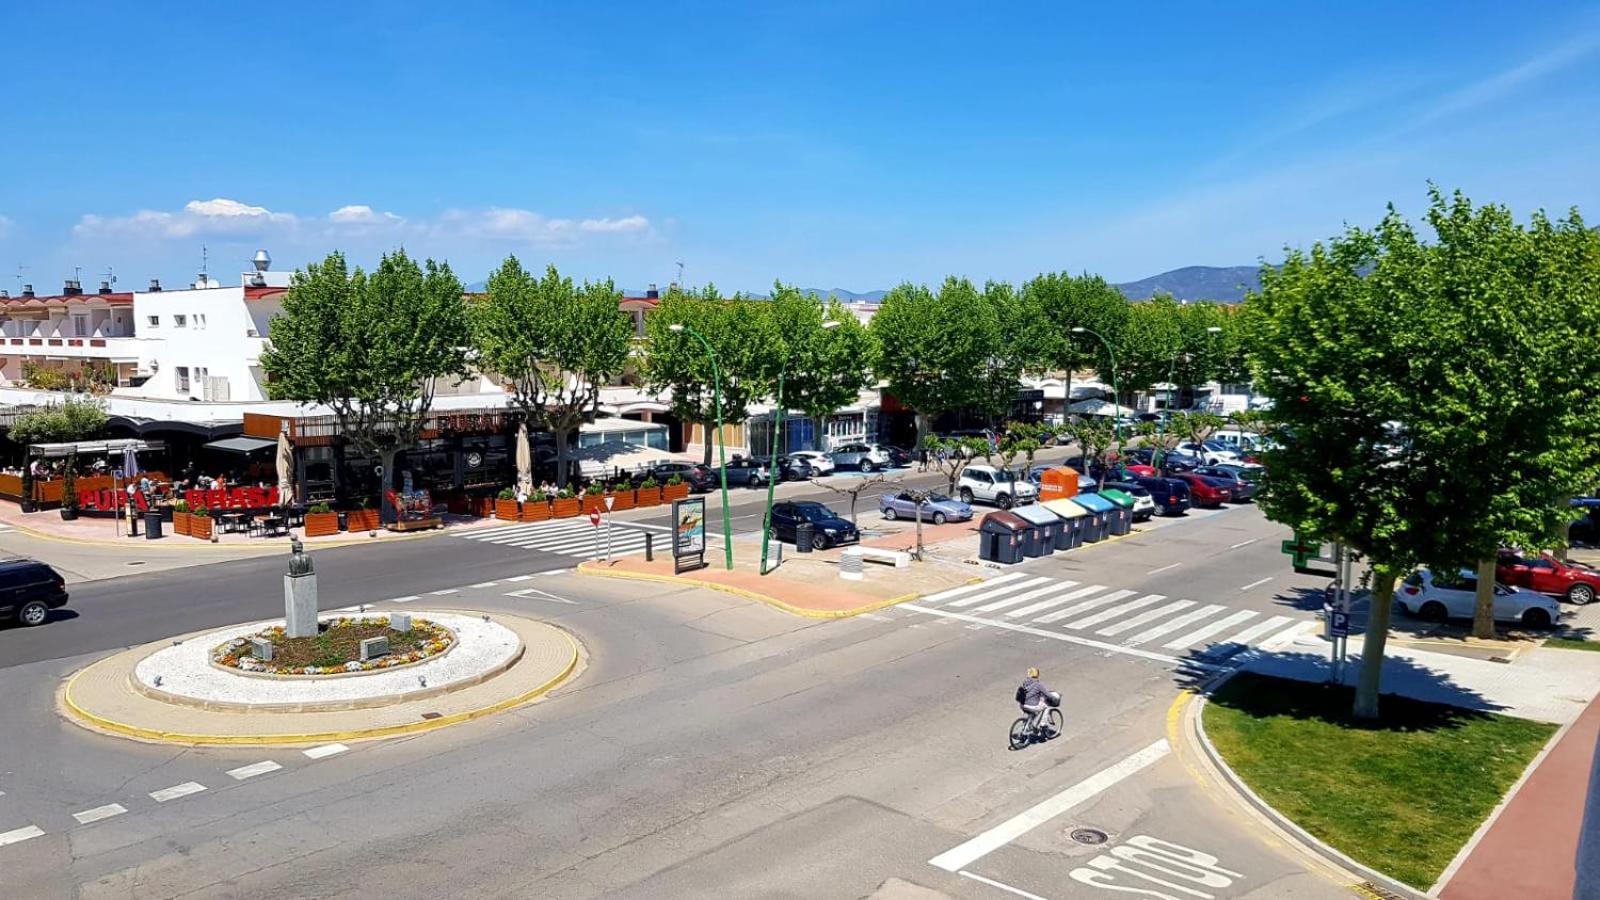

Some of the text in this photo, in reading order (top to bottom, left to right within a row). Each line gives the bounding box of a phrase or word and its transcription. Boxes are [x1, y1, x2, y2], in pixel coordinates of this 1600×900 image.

[80, 488, 149, 512] PURA
[1334, 613, 1346, 627] P
[1069, 835, 1247, 900] STOP
